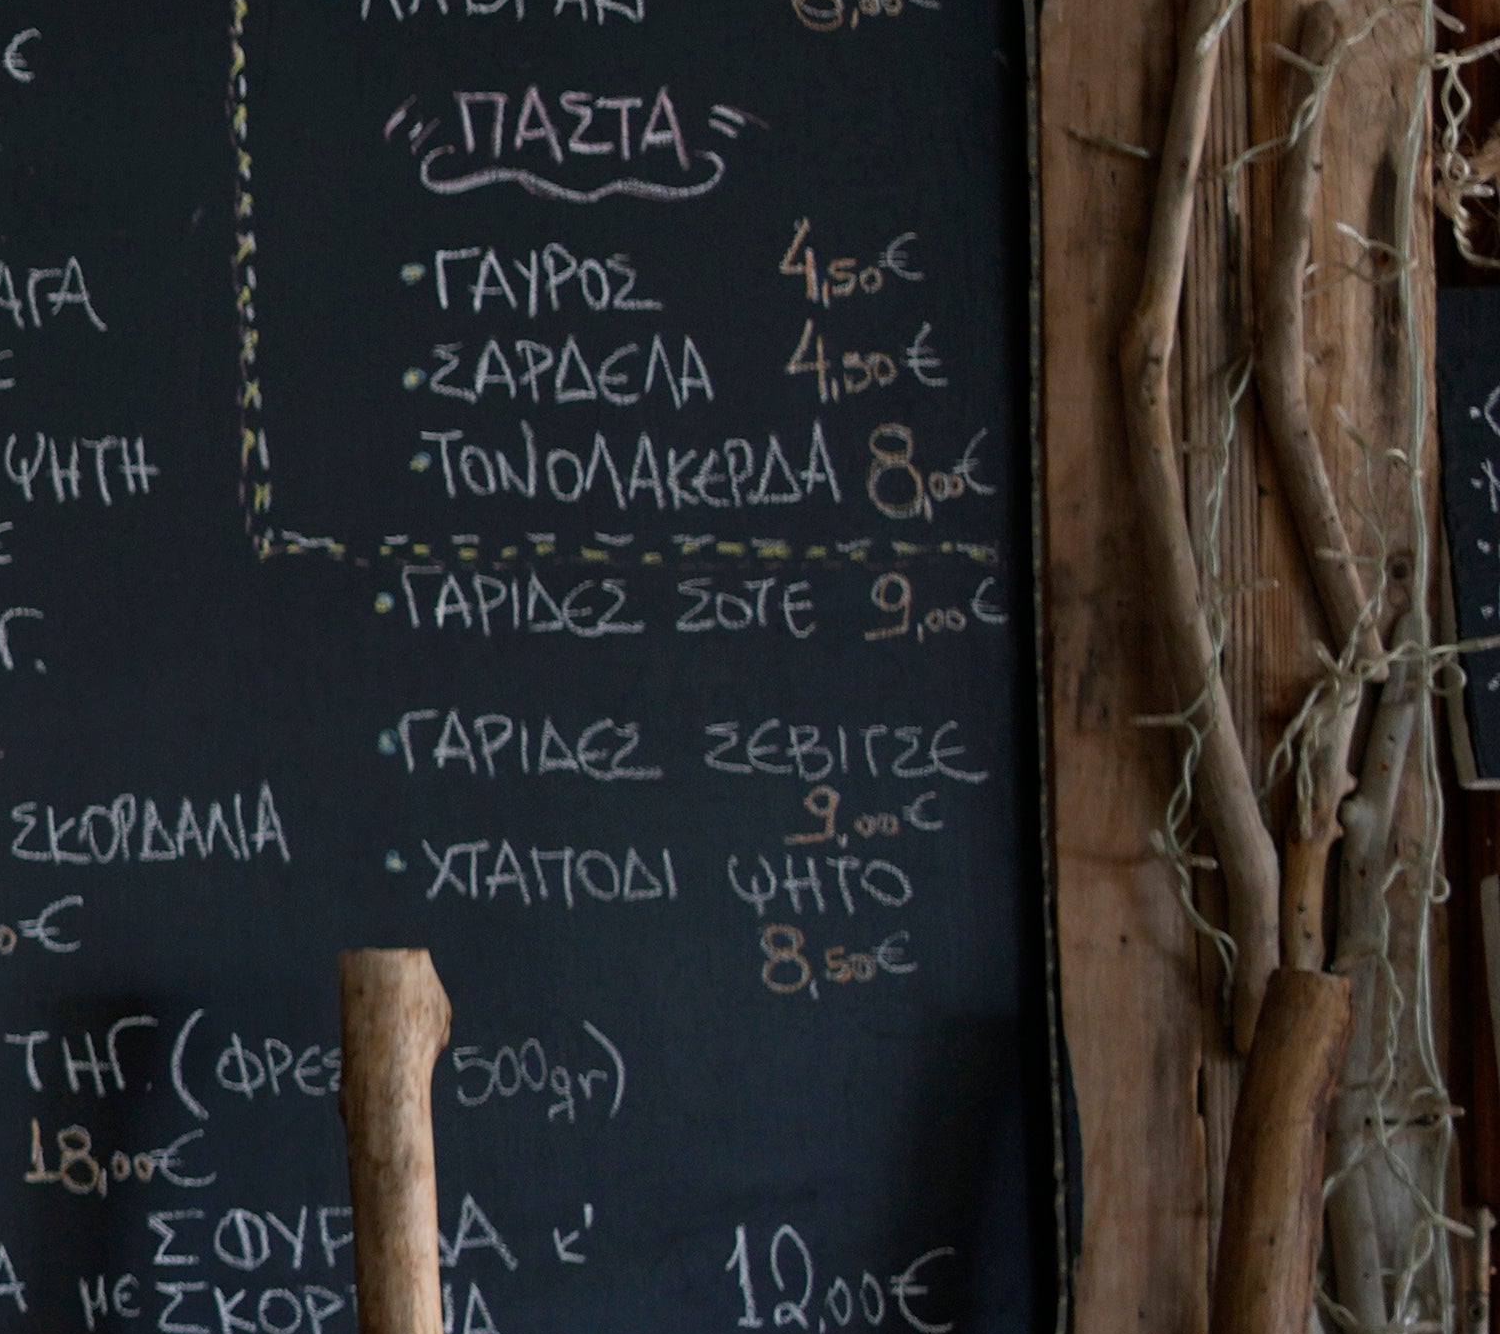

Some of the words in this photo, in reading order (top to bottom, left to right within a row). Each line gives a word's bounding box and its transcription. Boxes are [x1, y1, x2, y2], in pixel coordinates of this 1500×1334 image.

[434, 241, 664, 318] ΓΑΥΡΟΣ
[429, 334, 714, 409] ΣΑΡΔΕΛΑ
[4, 432, 160, 505] ΨΗΤΗ
[401, 566, 646, 638] ΓΑΡΙΔΕΣ
[398, 707, 664, 781] ΓΑΡΙΔΕΣ
[421, 839, 678, 909] ΧΤΑΠΟΔΙ
[728, 853, 912, 916] ΨΗΤΟ
